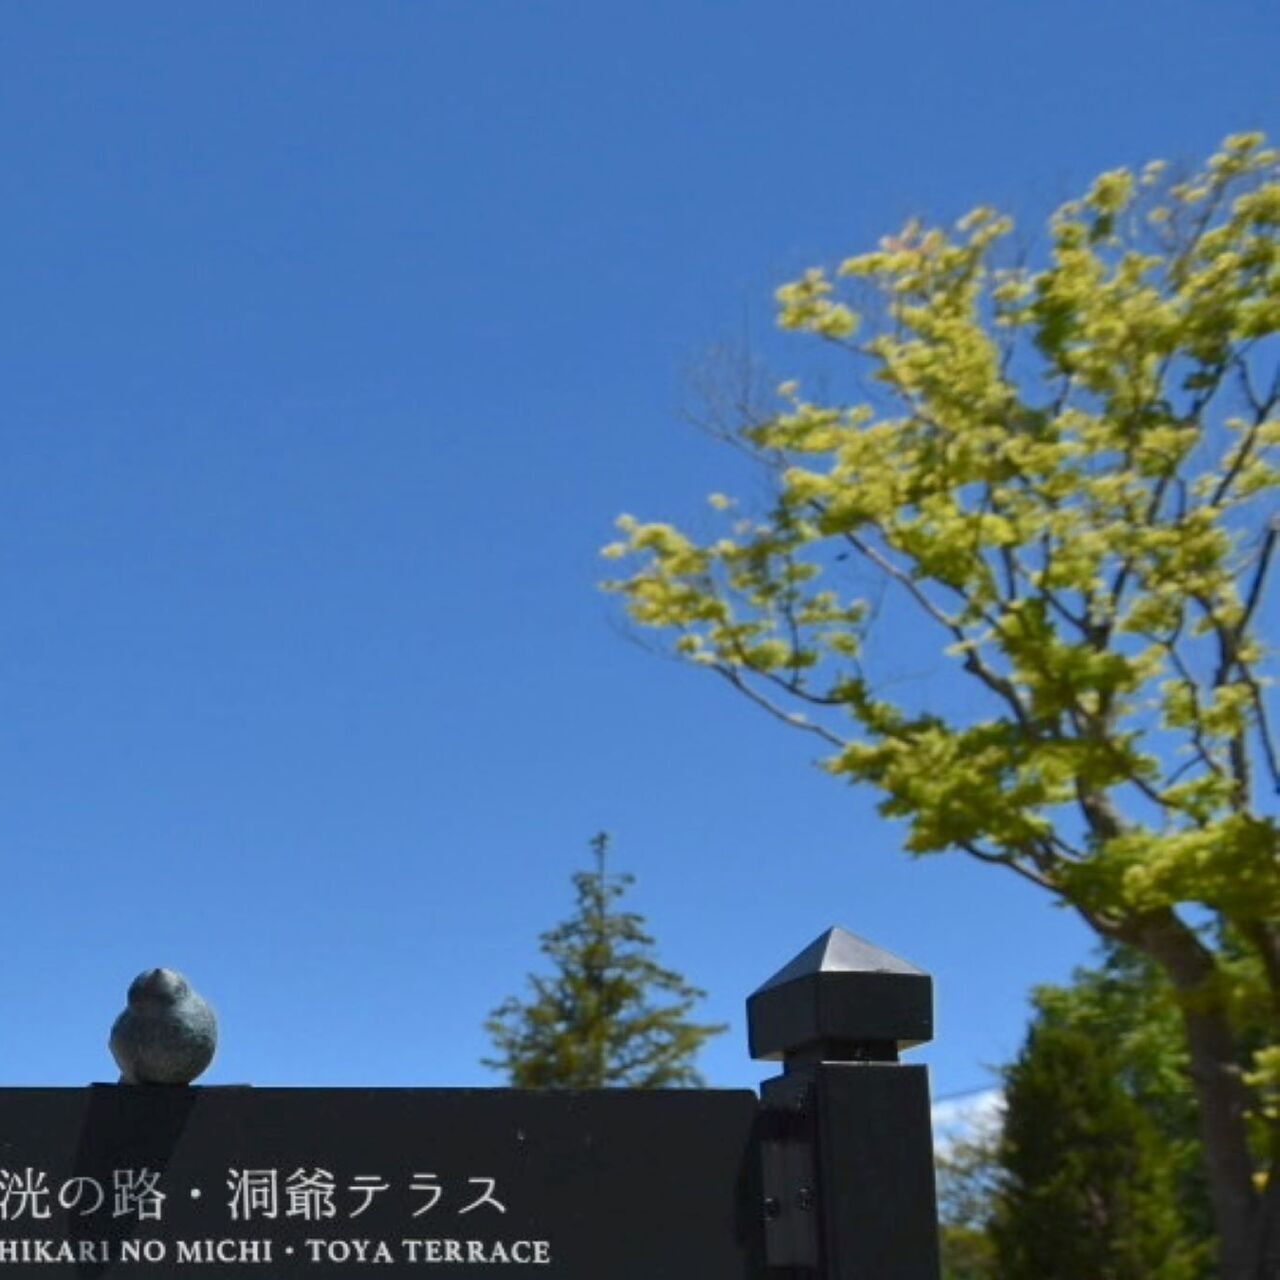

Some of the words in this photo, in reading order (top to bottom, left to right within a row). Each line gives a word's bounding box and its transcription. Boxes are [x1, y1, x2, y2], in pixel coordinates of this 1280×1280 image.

[120, 1239, 167, 1263] NO
[175, 1239, 273, 1263] MICHI
[304, 1239, 394, 1264] TOYA
[400, 1239, 550, 1264] TERRACE
